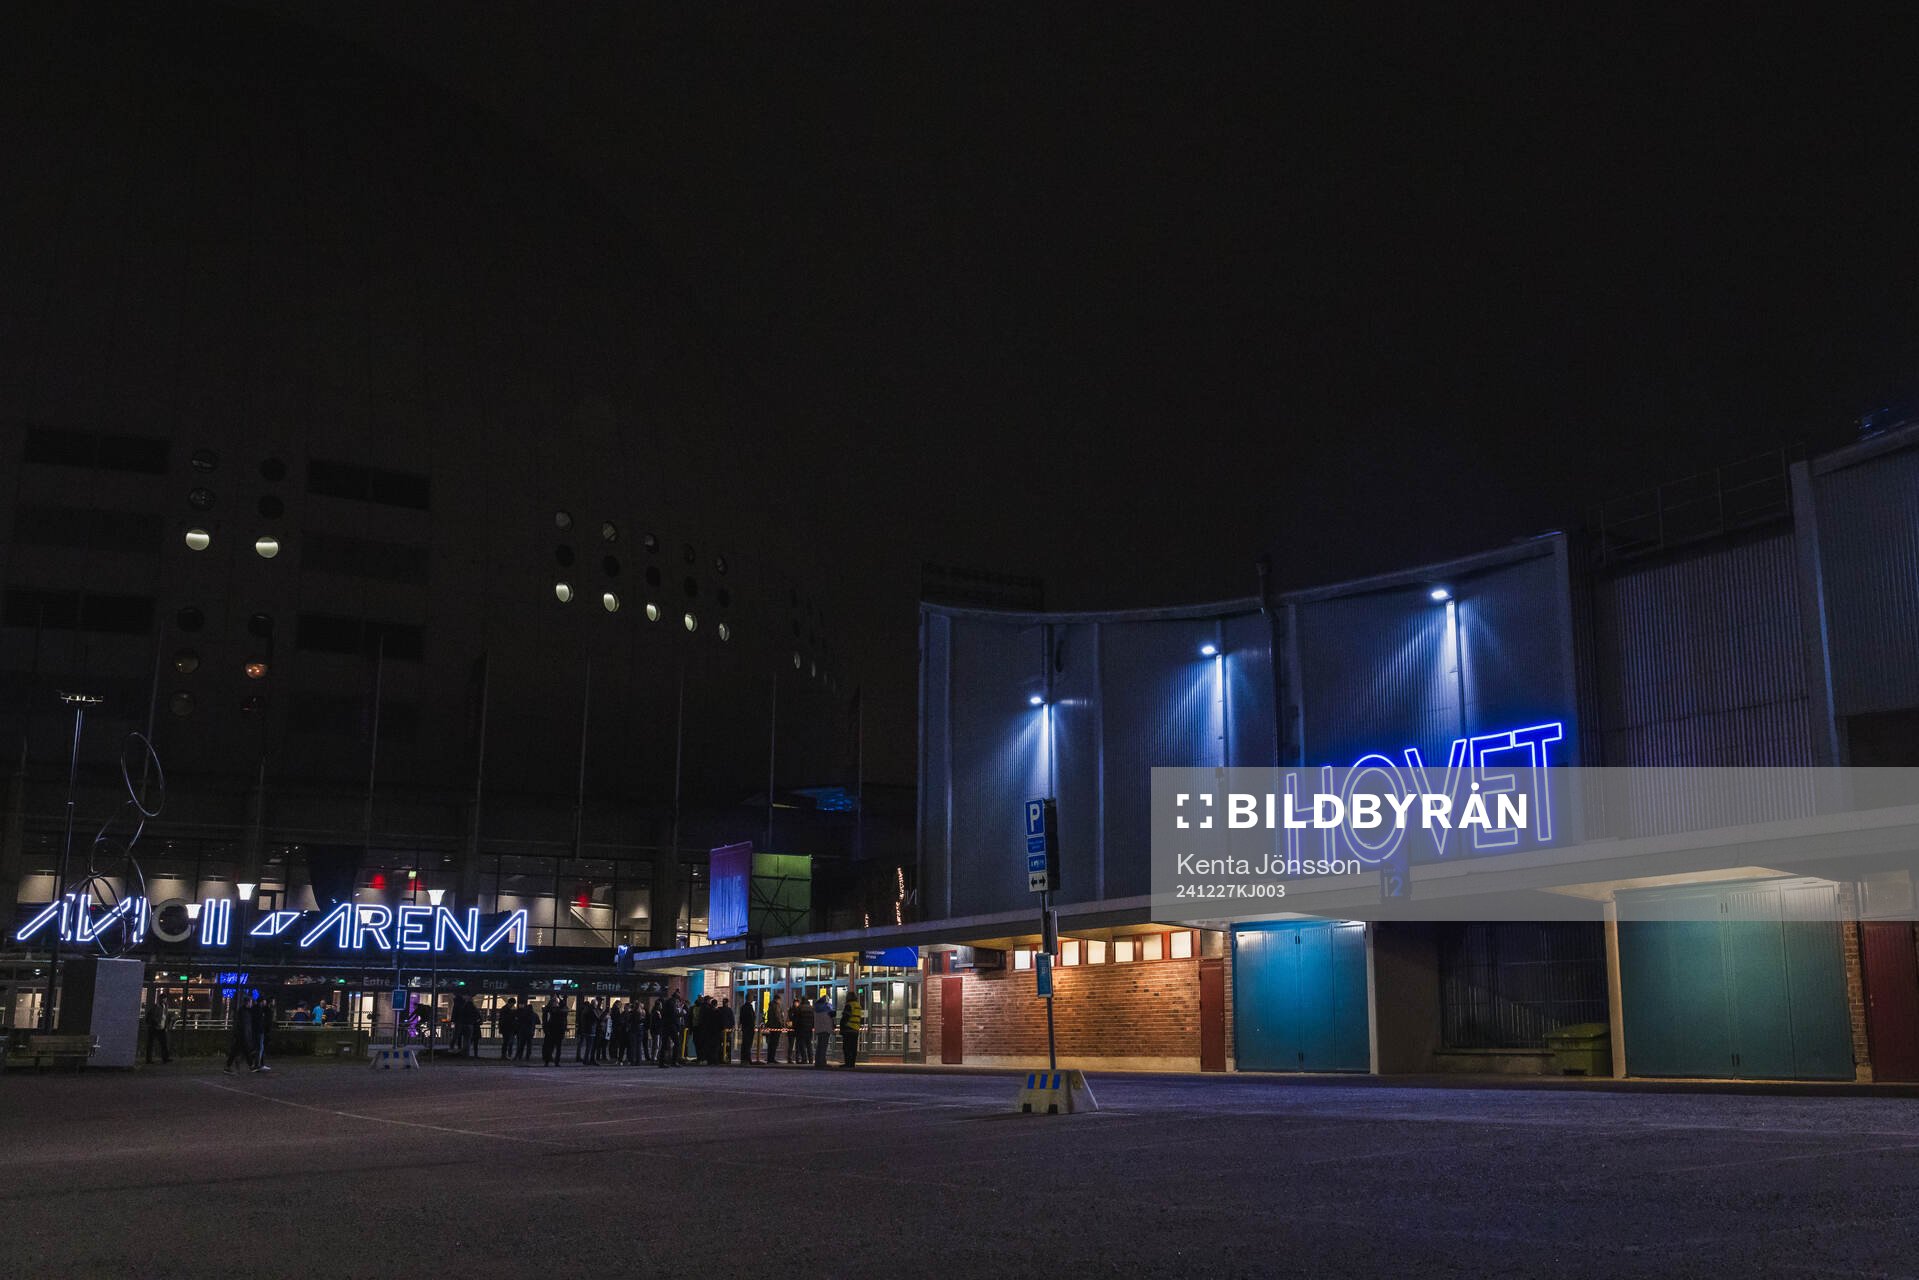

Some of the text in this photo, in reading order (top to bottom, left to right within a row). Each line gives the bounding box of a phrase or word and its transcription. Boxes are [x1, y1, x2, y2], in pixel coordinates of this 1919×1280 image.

[1029, 803, 1041, 833] P
[1286, 721, 1563, 874] HOVET
[300, 902, 528, 953] ARENA
